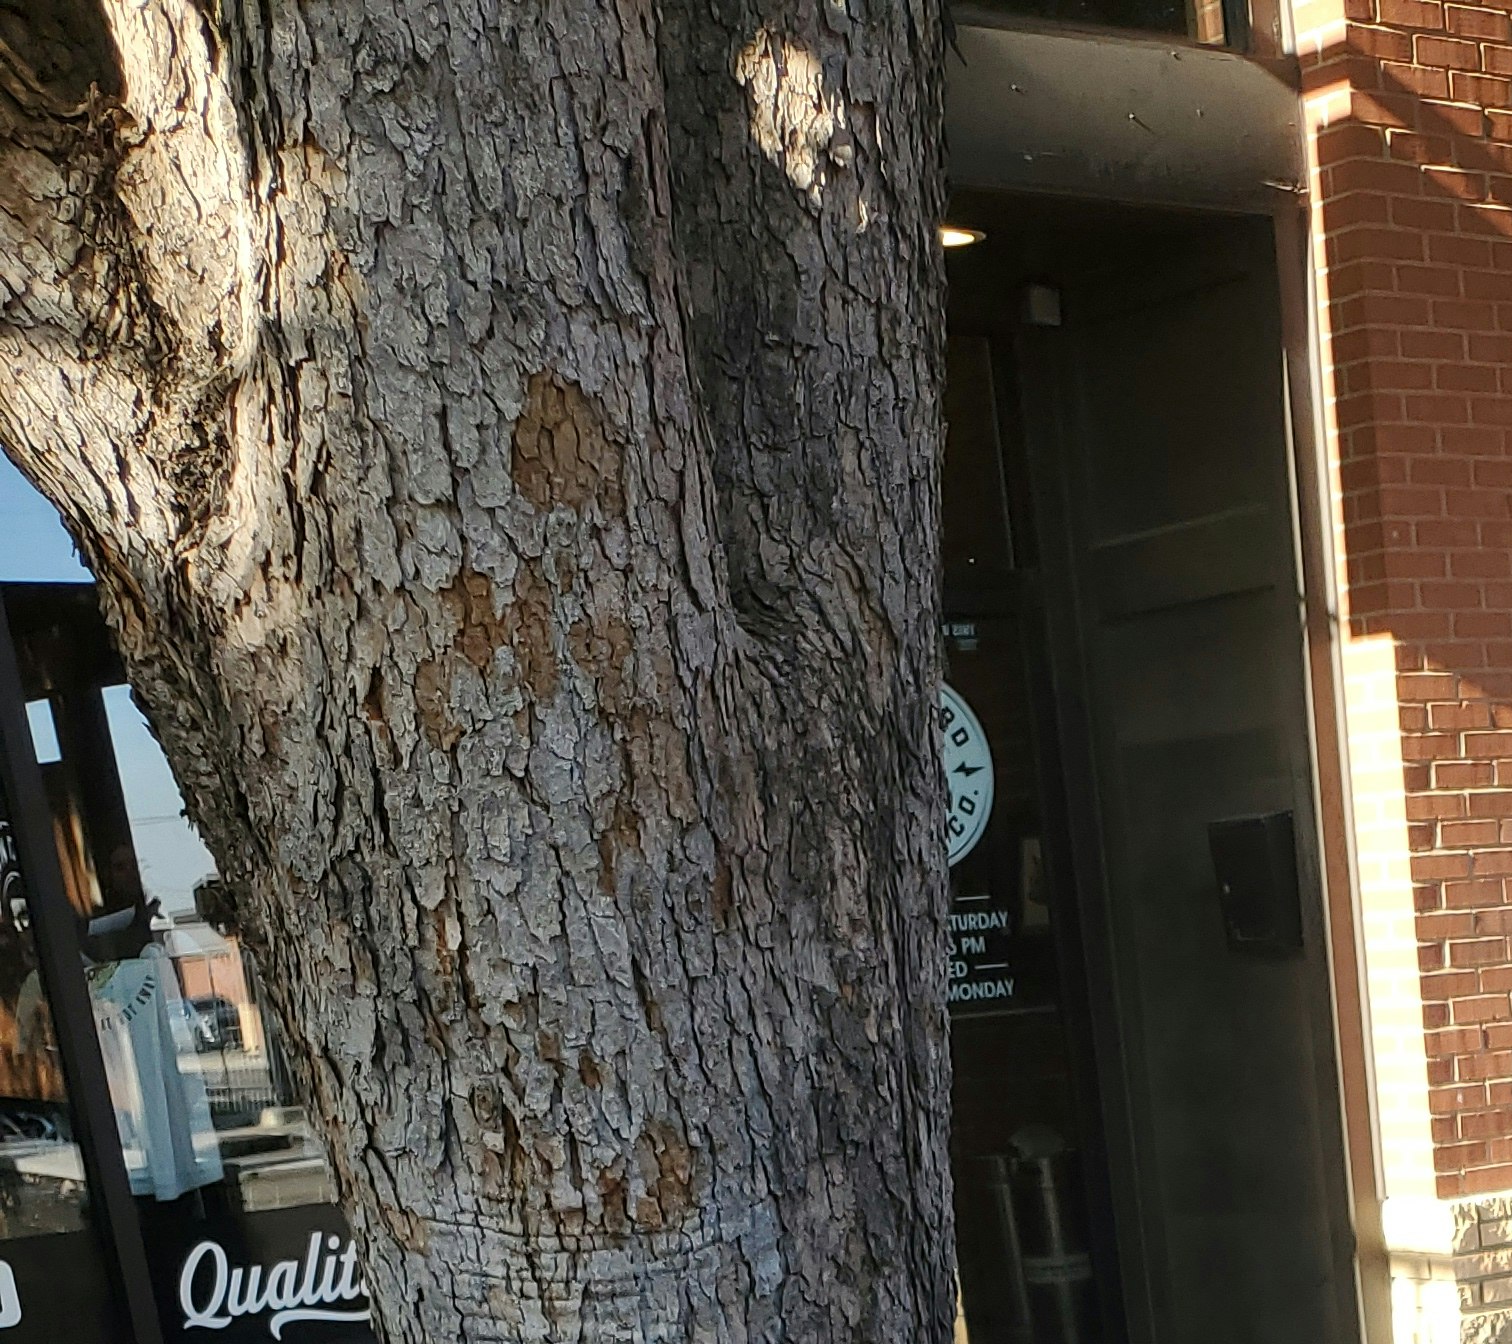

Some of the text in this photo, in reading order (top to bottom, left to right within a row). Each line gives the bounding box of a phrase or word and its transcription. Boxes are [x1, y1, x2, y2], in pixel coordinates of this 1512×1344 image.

[948, 909, 1009, 931] TURDAY
[960, 936, 986, 955] PM
[180, 1231, 370, 1341] Qualit
